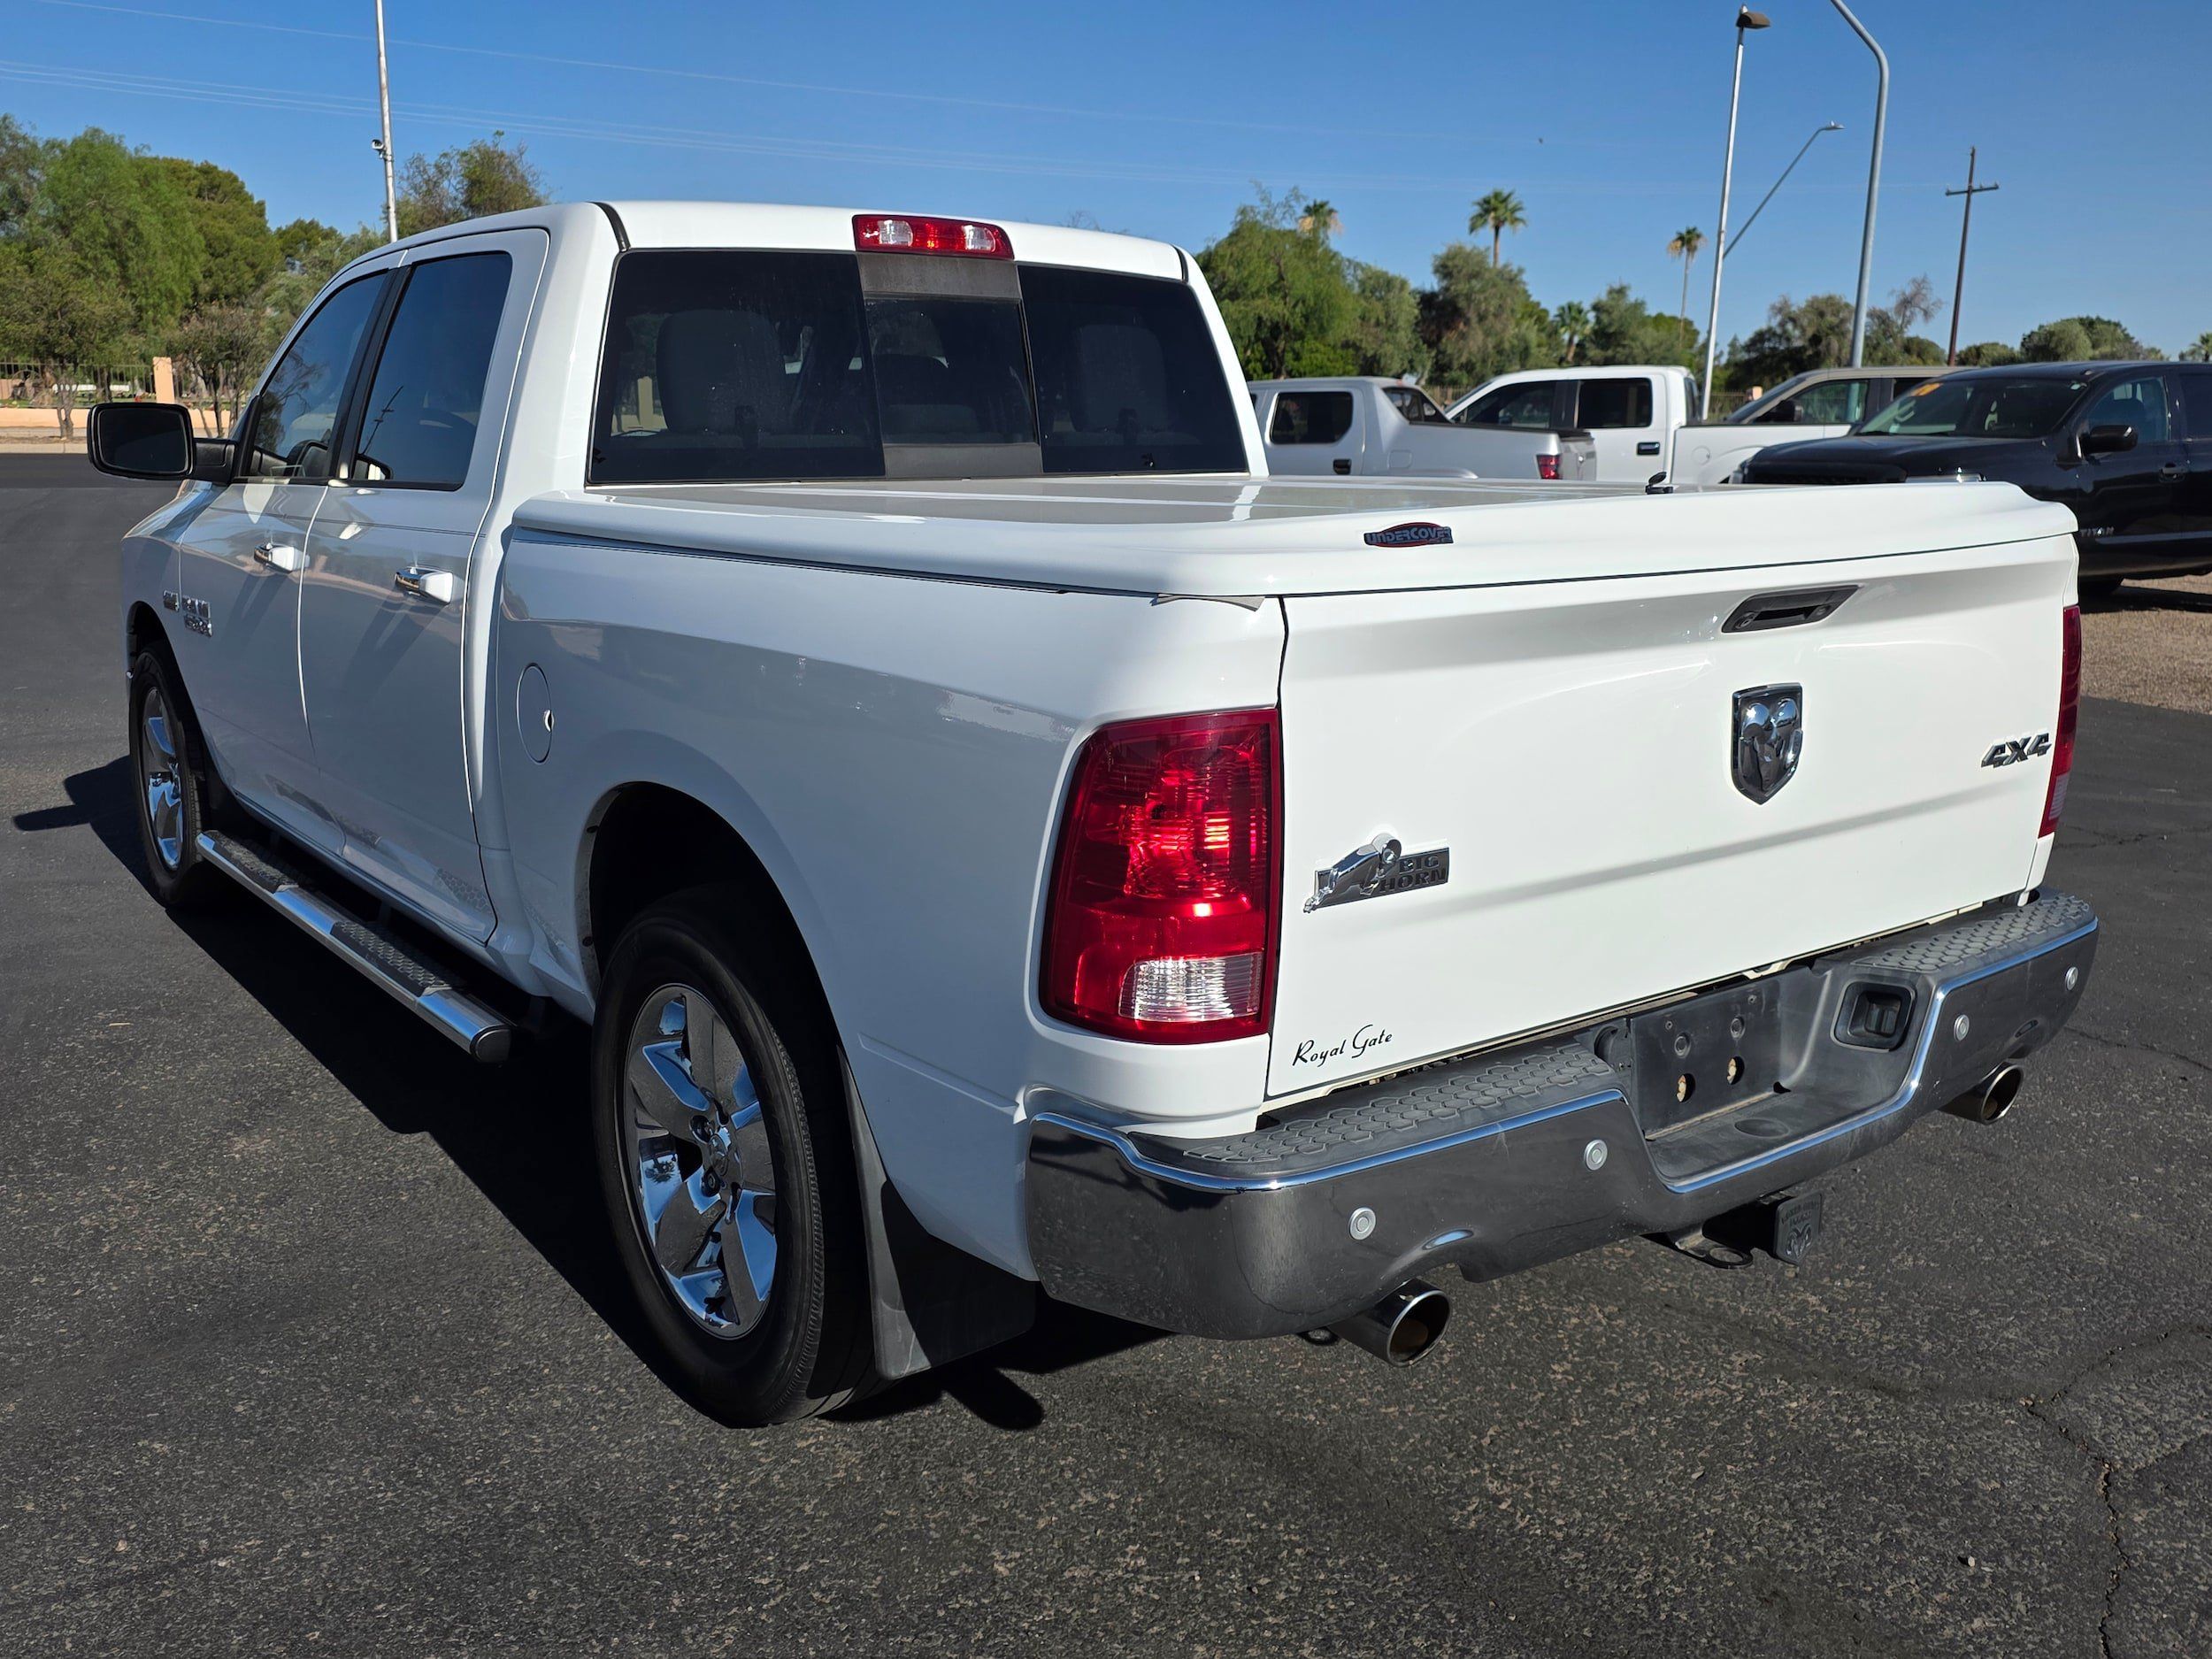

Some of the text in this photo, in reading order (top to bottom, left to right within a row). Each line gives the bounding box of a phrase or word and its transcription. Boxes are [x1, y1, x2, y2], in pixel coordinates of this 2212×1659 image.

[1399, 854, 1440, 873] BIG
[1379, 868, 1448, 893] HORN
[1291, 1024, 1393, 1068] Royal Gate
